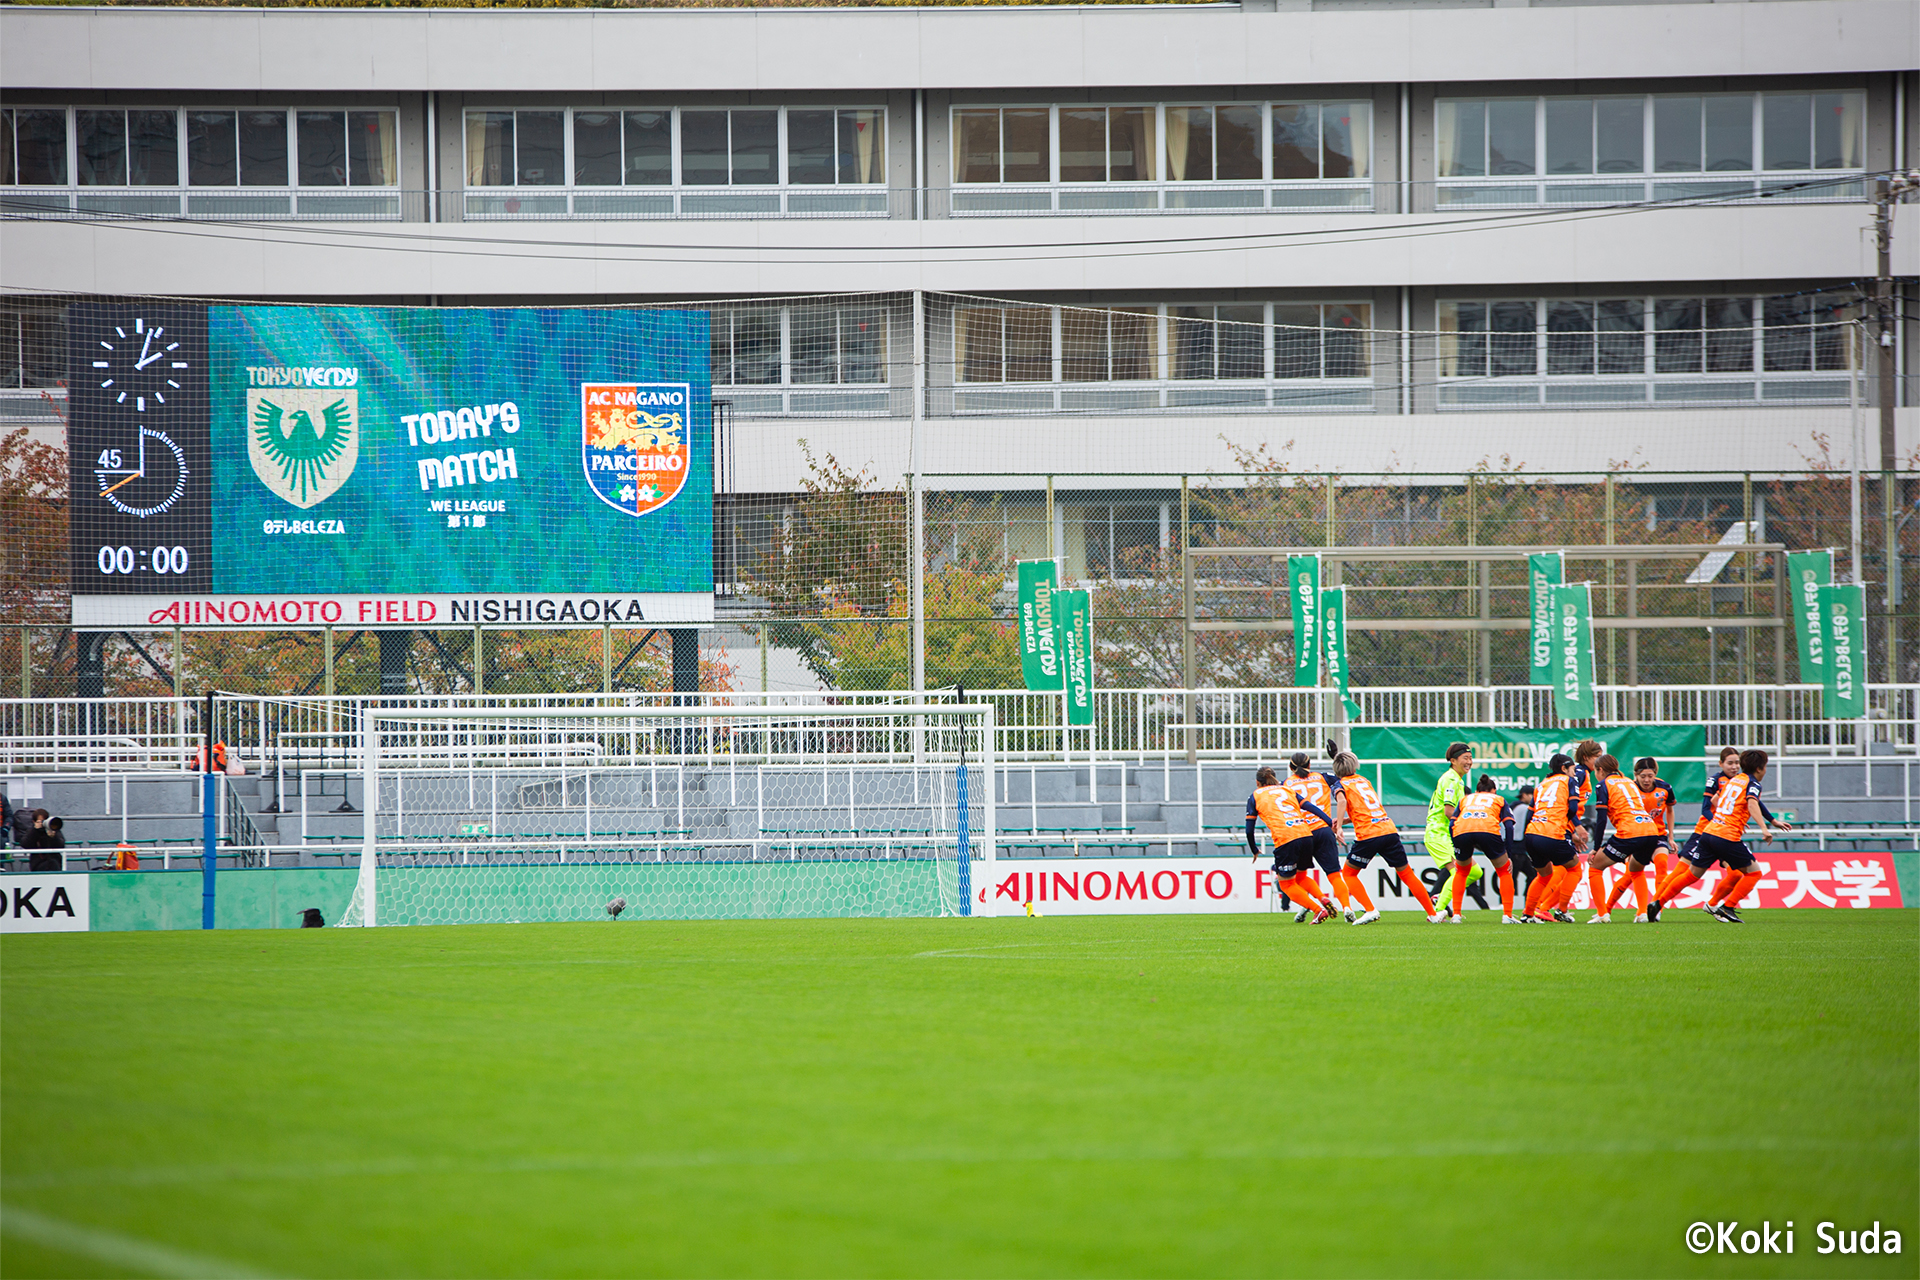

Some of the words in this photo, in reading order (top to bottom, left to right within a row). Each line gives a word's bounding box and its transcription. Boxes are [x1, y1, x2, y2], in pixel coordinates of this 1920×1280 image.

[588, 391, 611, 406] AC
[614, 391, 683, 406] NAGANO
[401, 401, 520, 447] TODAY'S
[97, 449, 122, 468] 45
[417, 447, 518, 491] MATCH
[591, 454, 683, 472] PARCEIRO
[454, 500, 506, 512] LEAGUE
[98, 546, 188, 575] 00:00
[148, 600, 342, 624] AJINOMOTO
[359, 600, 437, 623] FIELD
[451, 599, 645, 622] NISHIGAOKA
[1268, 789, 1295, 812] 2
[1355, 782, 1380, 809] 6
[1617, 783, 1645, 809] 11
